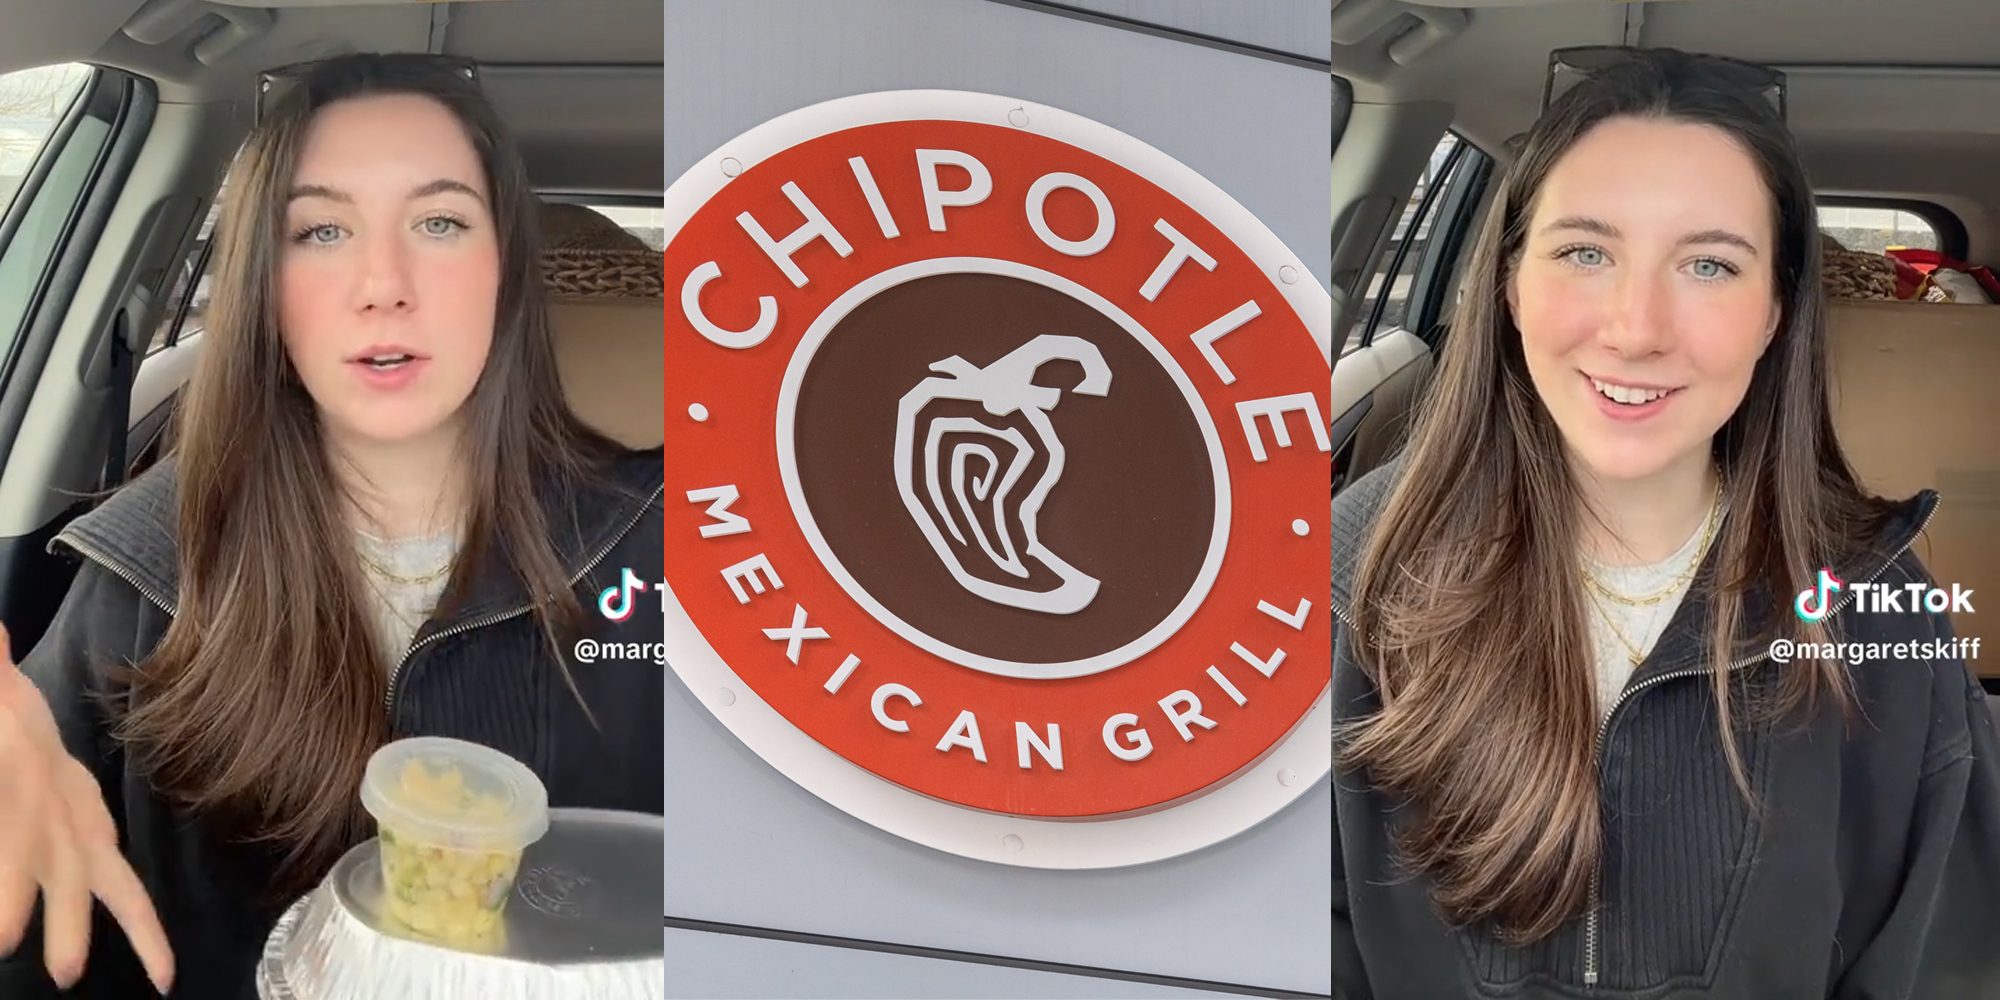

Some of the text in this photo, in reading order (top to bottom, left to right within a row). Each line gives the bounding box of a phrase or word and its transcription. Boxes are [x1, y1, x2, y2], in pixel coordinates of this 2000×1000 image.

[681, 148, 1331, 462] CHIPOTLE
[686, 484, 1312, 770] MEXICAN GRILL
